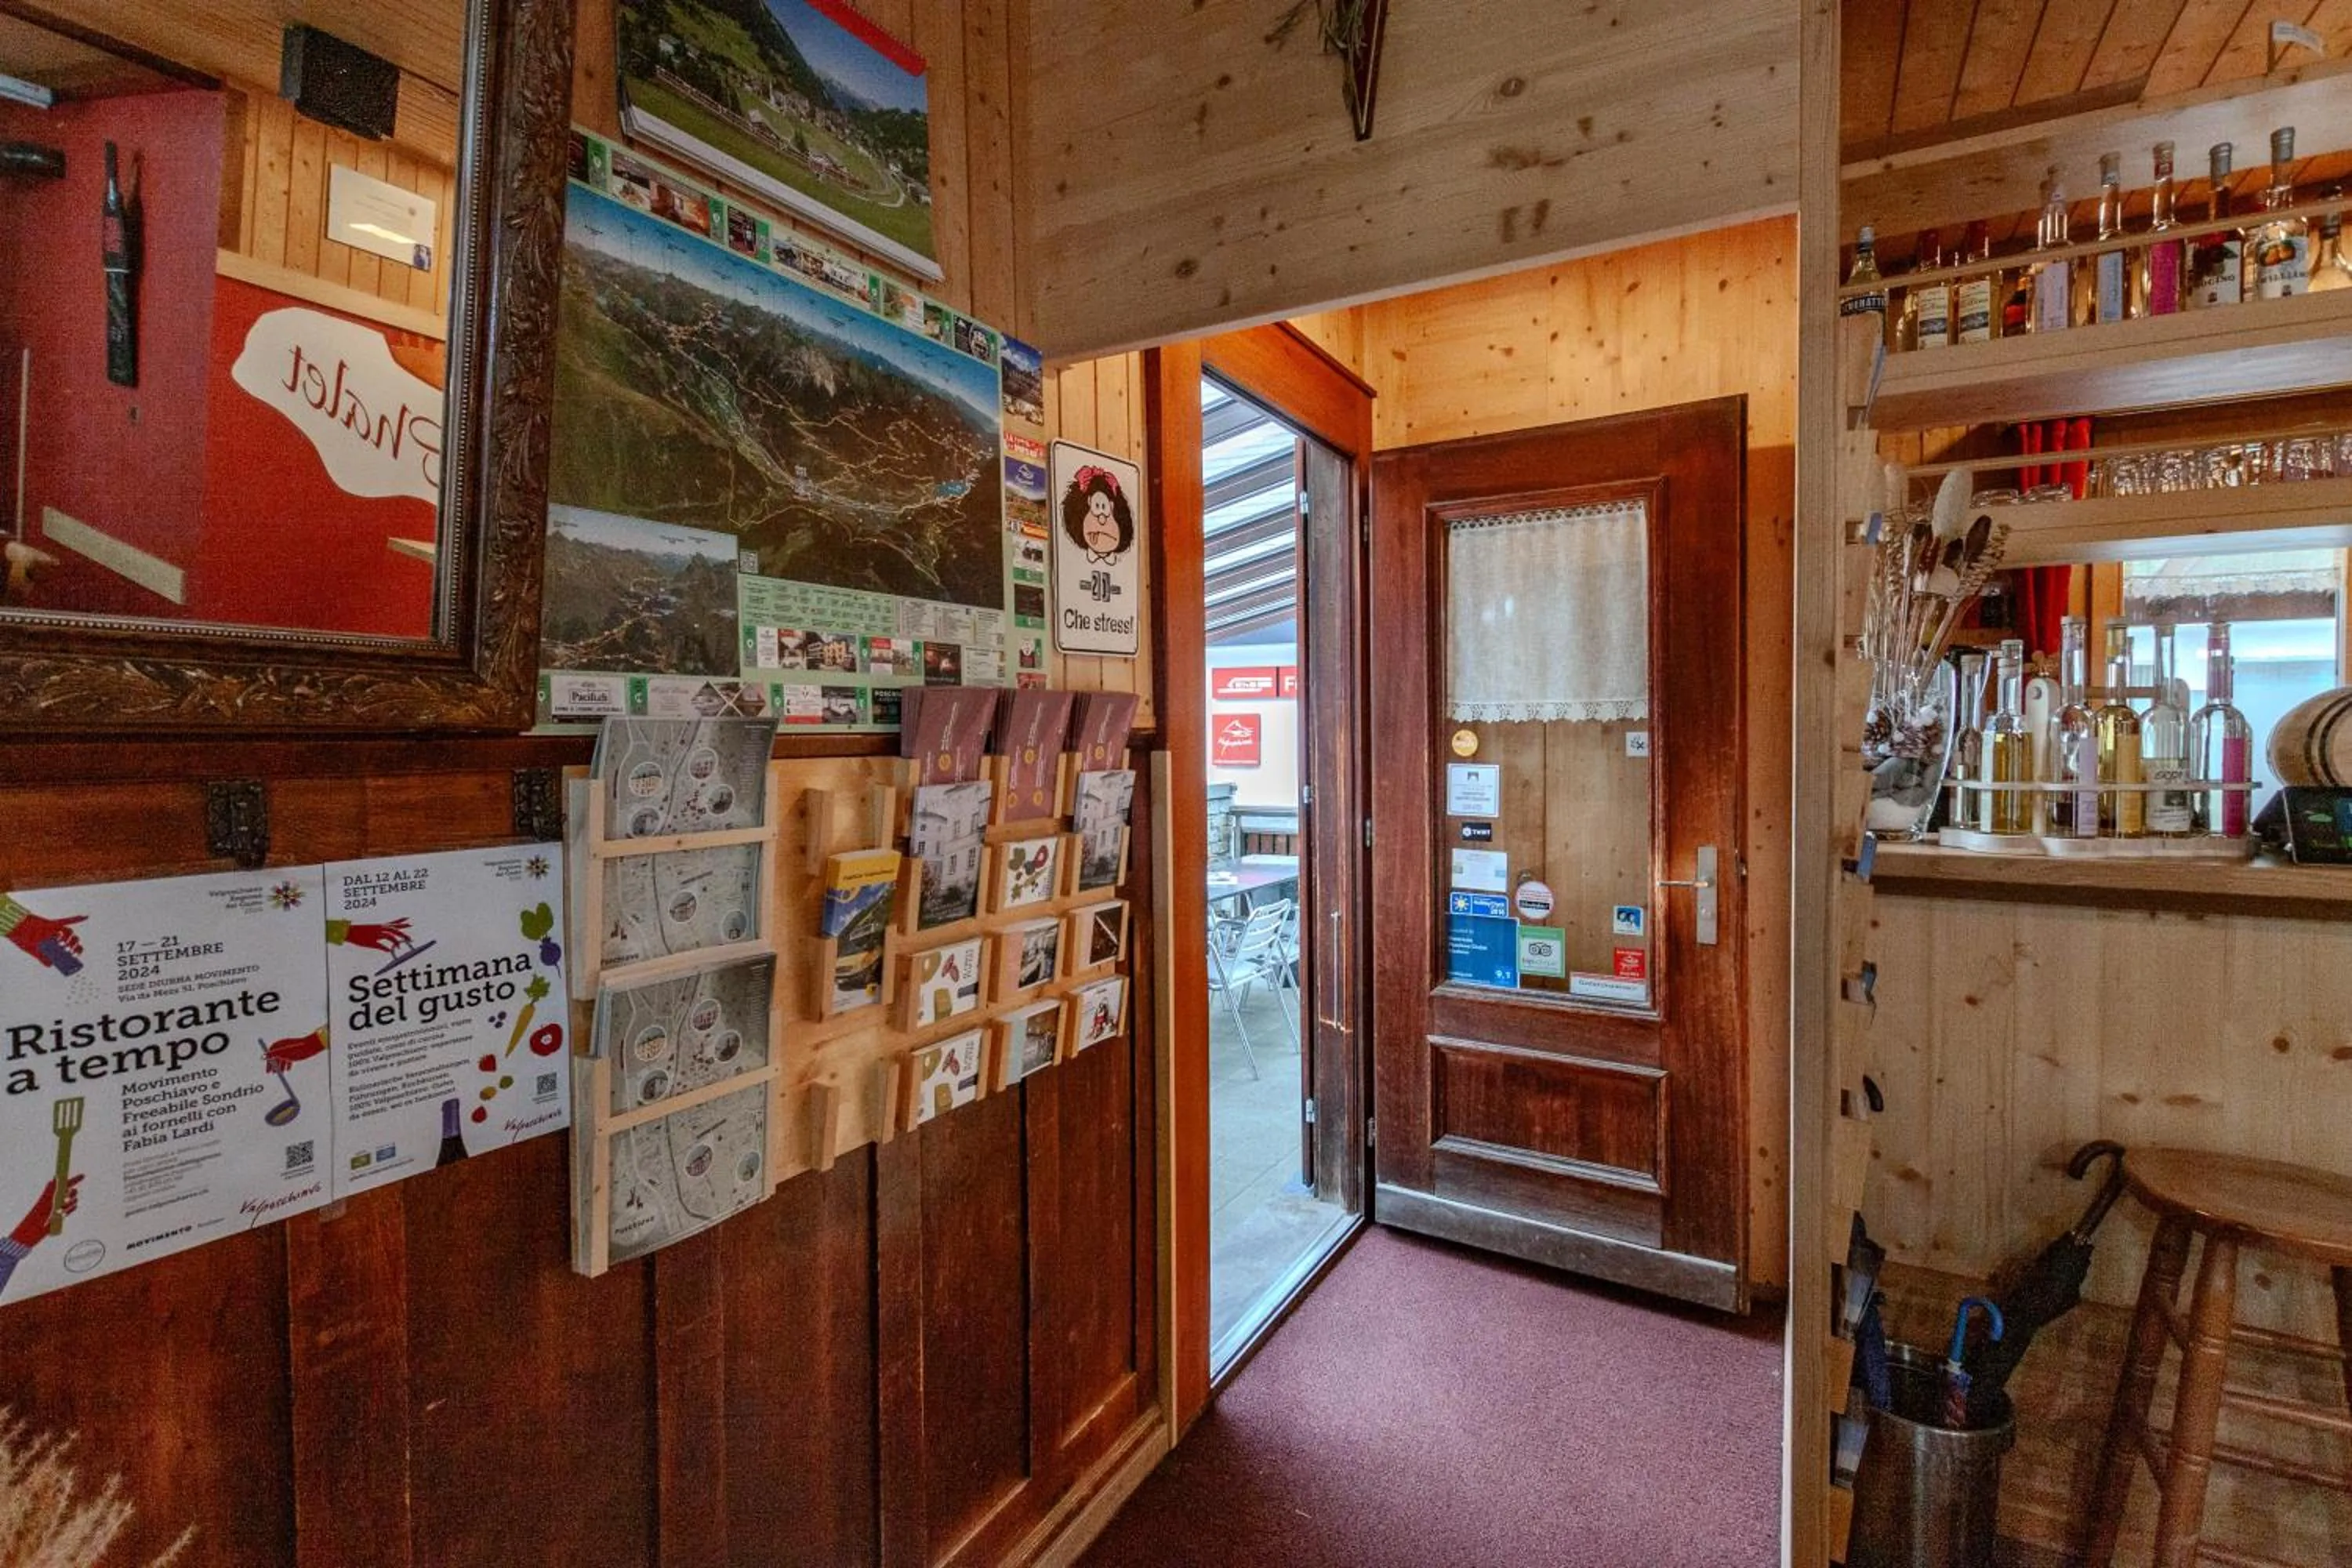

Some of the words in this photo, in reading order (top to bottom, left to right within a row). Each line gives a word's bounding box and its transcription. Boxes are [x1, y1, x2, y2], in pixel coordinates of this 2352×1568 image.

[1064, 608, 1091, 630] Che
[1094, 612, 1134, 634] stress!
[343, 874, 372, 887] DAL
[375, 872, 390, 883] 12
[393, 870, 412, 881] AL
[413, 868, 430, 879] 22
[343, 880, 426, 899] SETTEMBRE
[343, 897, 378, 911] 2024
[118, 940, 136, 953] 17
[161, 935, 180, 948] 21
[118, 942, 224, 967] SETTEMBRE
[118, 964, 161, 982] 2024
[194, 964, 260, 982] MOVIMENTO
[348, 953, 533, 1004] Settimana
[349, 990, 408, 1032] del
[418, 980, 516, 1024] gusto
[5, 990, 281, 1061] Ristorante
[6, 1068, 40, 1095] a
[56, 1032, 230, 1083] tempo
[121, 1068, 219, 1096] Movimento
[122, 1083, 208, 1110] Poschiavo
[211, 1080, 221, 1090] e
[122, 1098, 198, 1125] Freeabile
[201, 1083, 264, 1105] Sondrio
[122, 1126, 138, 1138] ai
[142, 1112, 204, 1134] fornelli
[206, 1103, 238, 1118] con
[122, 1133, 168, 1153] Fabia
[172, 1120, 215, 1140] Lardi
[126, 1225, 193, 1250] MOVIMENTO
